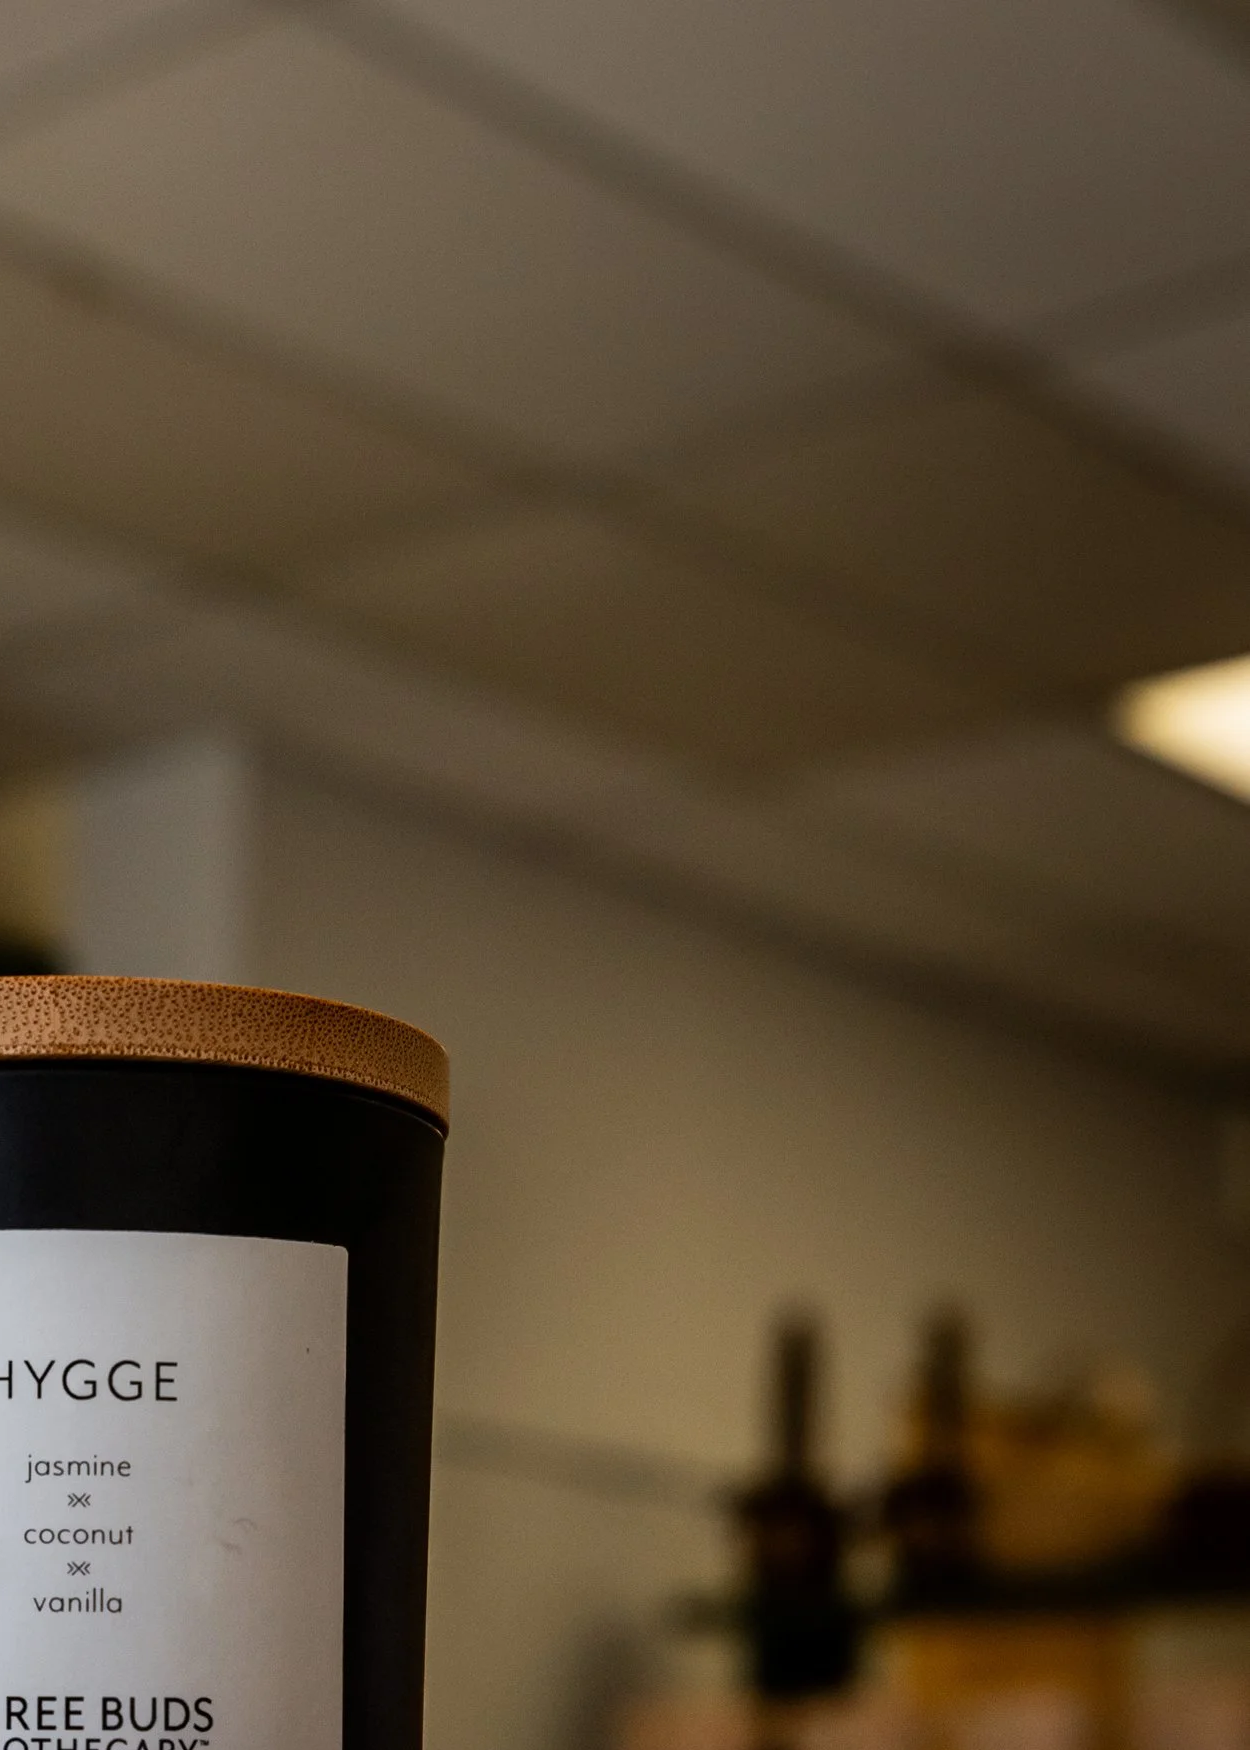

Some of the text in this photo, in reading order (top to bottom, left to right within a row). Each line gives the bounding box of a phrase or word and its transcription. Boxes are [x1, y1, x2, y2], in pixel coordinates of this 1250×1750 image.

[25, 1455, 131, 1483] jasmine
[24, 1525, 134, 1545] coconut
[33, 1588, 122, 1613] vanilla
[101, 1698, 214, 1732] BUDS
